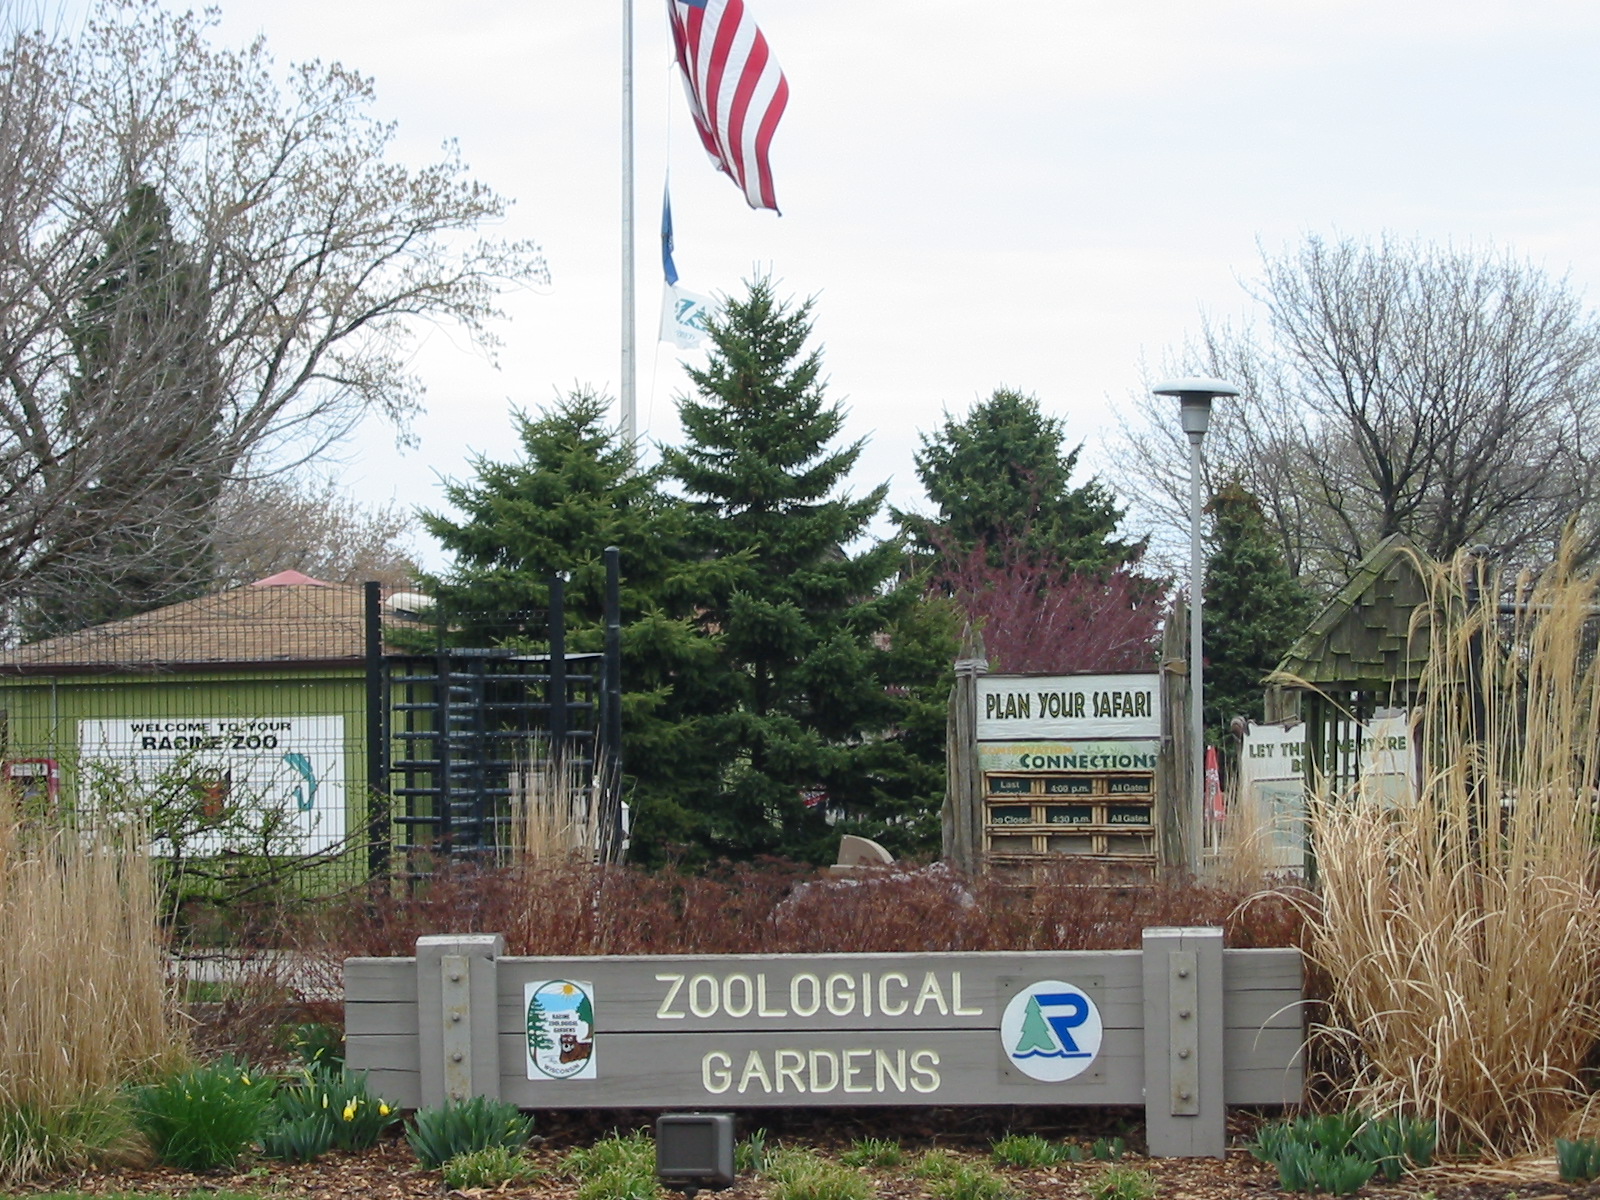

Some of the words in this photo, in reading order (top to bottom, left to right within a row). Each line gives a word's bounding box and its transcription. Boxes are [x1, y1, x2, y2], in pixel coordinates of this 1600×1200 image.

[986, 693, 1030, 720] PLAN
[1038, 691, 1086, 718] YOUR
[1093, 691, 1152, 718] SAFARI
[131, 722, 210, 732] WELCOME
[218, 722, 238, 732] TO
[247, 721, 291, 732] YOUR
[142, 735, 223, 750] RACINE
[232, 735, 278, 749] ZOO
[1249, 744, 1274, 758] LET
[1020, 753, 1157, 769] CONNECTIONS
[1000, 781, 1020, 790] Last
[1123, 784, 1148, 792] Gates
[1052, 815, 1070, 823] 4:30
[1123, 815, 1148, 823] Gates
[654, 970, 984, 1019] ZOOLOGICAL
[701, 1049, 941, 1095] GARDENS
